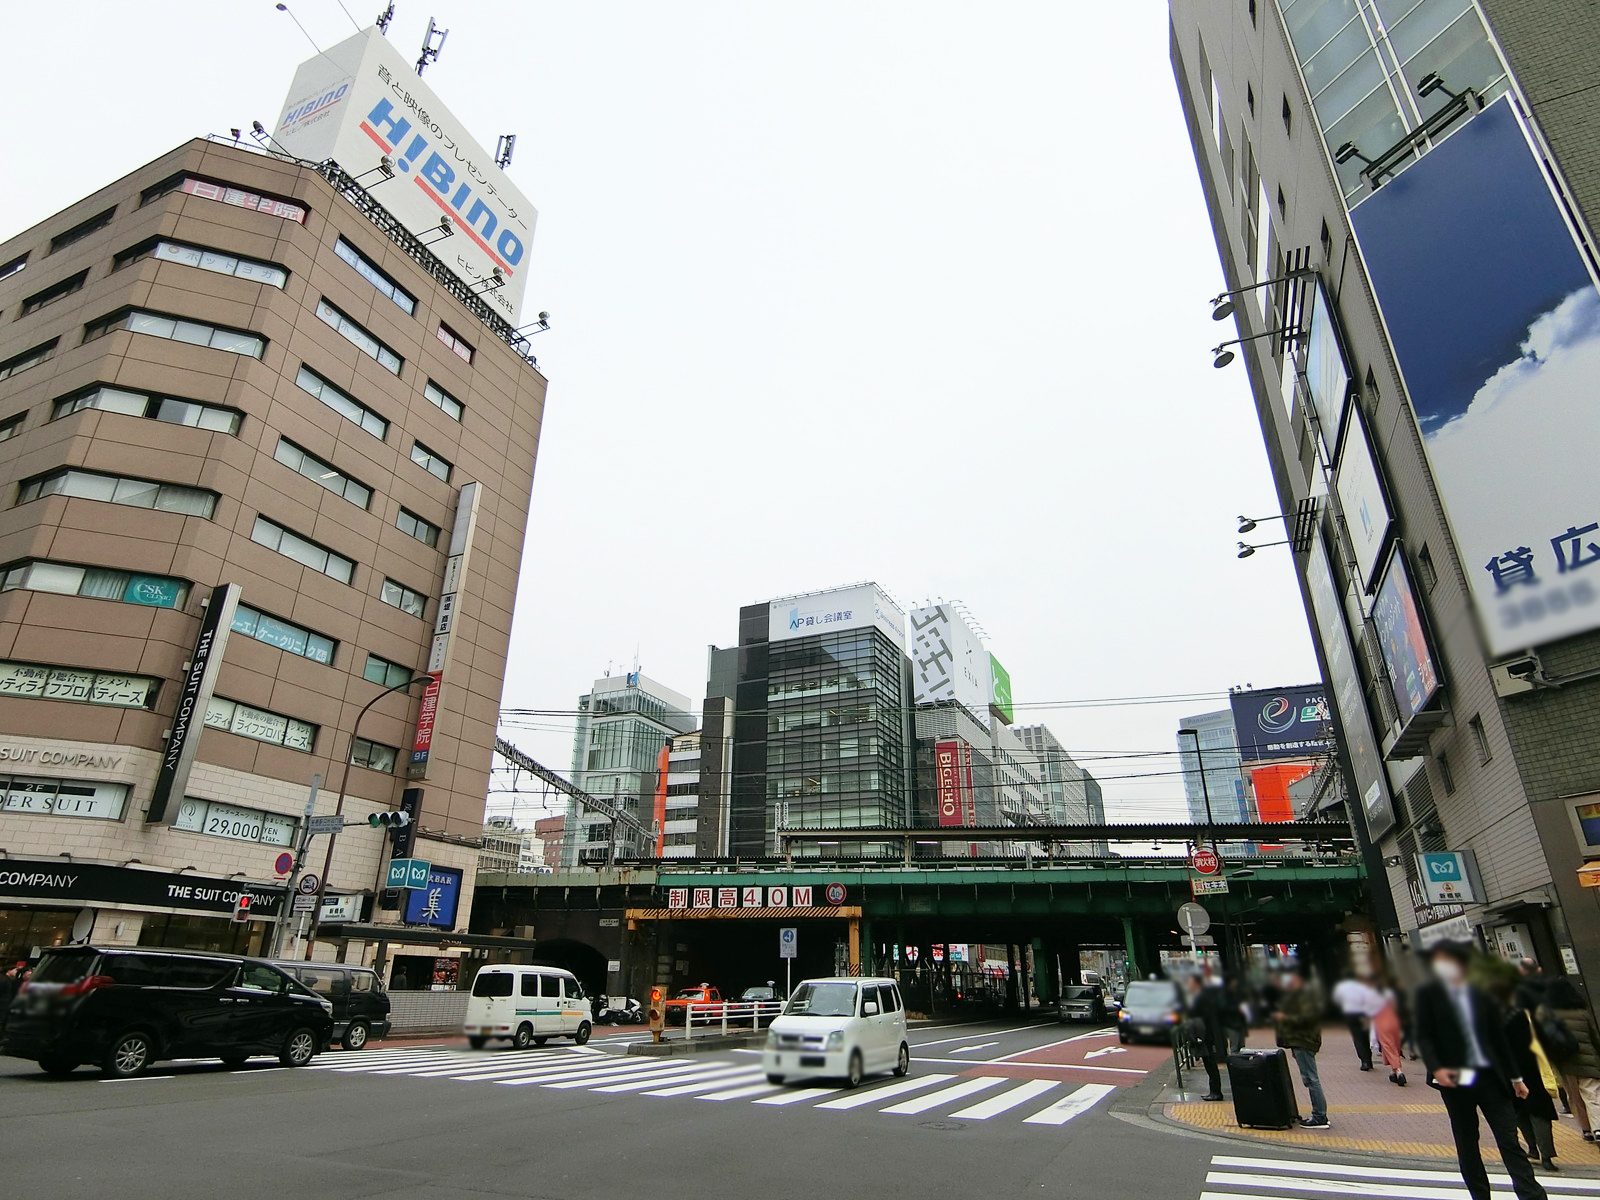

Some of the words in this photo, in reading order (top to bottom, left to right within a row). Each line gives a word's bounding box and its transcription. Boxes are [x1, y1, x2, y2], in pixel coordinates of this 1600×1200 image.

[187, 251, 274, 279] ホットヨガ
[136, 583, 164, 596] CSK
[805, 610, 853, 627] 貸し会議室
[197, 629, 214, 661] THE
[186, 660, 204, 695] SUIT
[240, 710, 311, 735] 不動産の総合マジメント
[416, 681, 440, 745] 日建学院
[165, 696, 194, 771] COMPANY
[40, 750, 122, 770] COMPANY
[414, 752, 427, 761] 9F
[939, 752, 952, 777] BIG
[25, 783, 45, 792] 2F
[943, 779, 955, 816] ECHO
[42, 797, 98, 813] SUIT
[209, 818, 260, 839] 29,000
[263, 826, 278, 836] YEN
[1194, 856, 1216, 867] 消火栓
[0, 871, 78, 888] COMPANY
[167, 884, 193, 899] THE
[194, 887, 222, 901] SUIT
[222, 890, 276, 907] COPANY
[421, 887, 442, 920] 集
